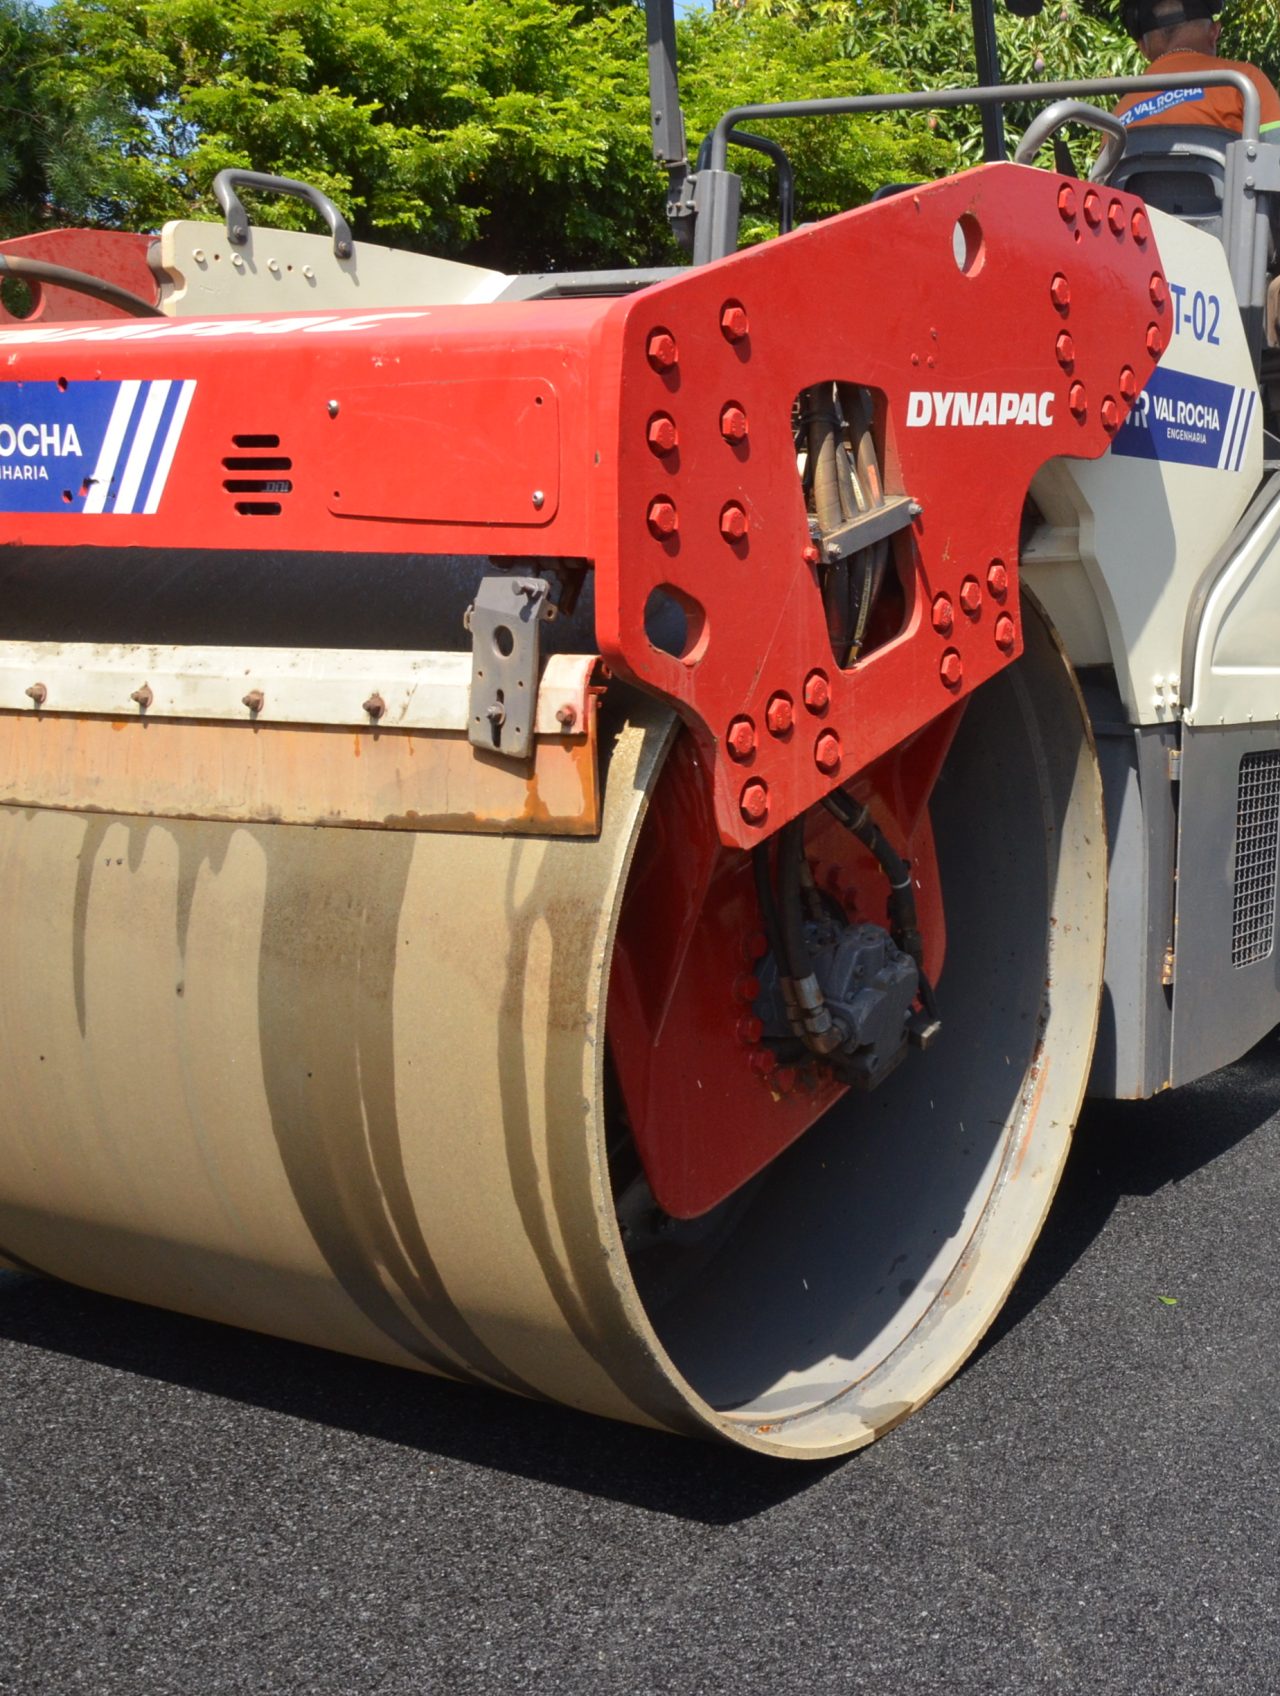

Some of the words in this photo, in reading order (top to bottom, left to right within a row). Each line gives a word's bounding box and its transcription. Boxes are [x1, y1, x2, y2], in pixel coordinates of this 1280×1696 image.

[0, 312, 431, 344] NAPAC
[1167, 281, 1221, 346] T-02
[906, 391, 1055, 427] DYNAPAC
[1126, 390, 1149, 429] R
[1153, 395, 1176, 423] VAL
[1176, 400, 1220, 431] ROCHA
[1166, 427, 1207, 444] ENGENHARIA
[0, 465, 49, 480] HARIA
